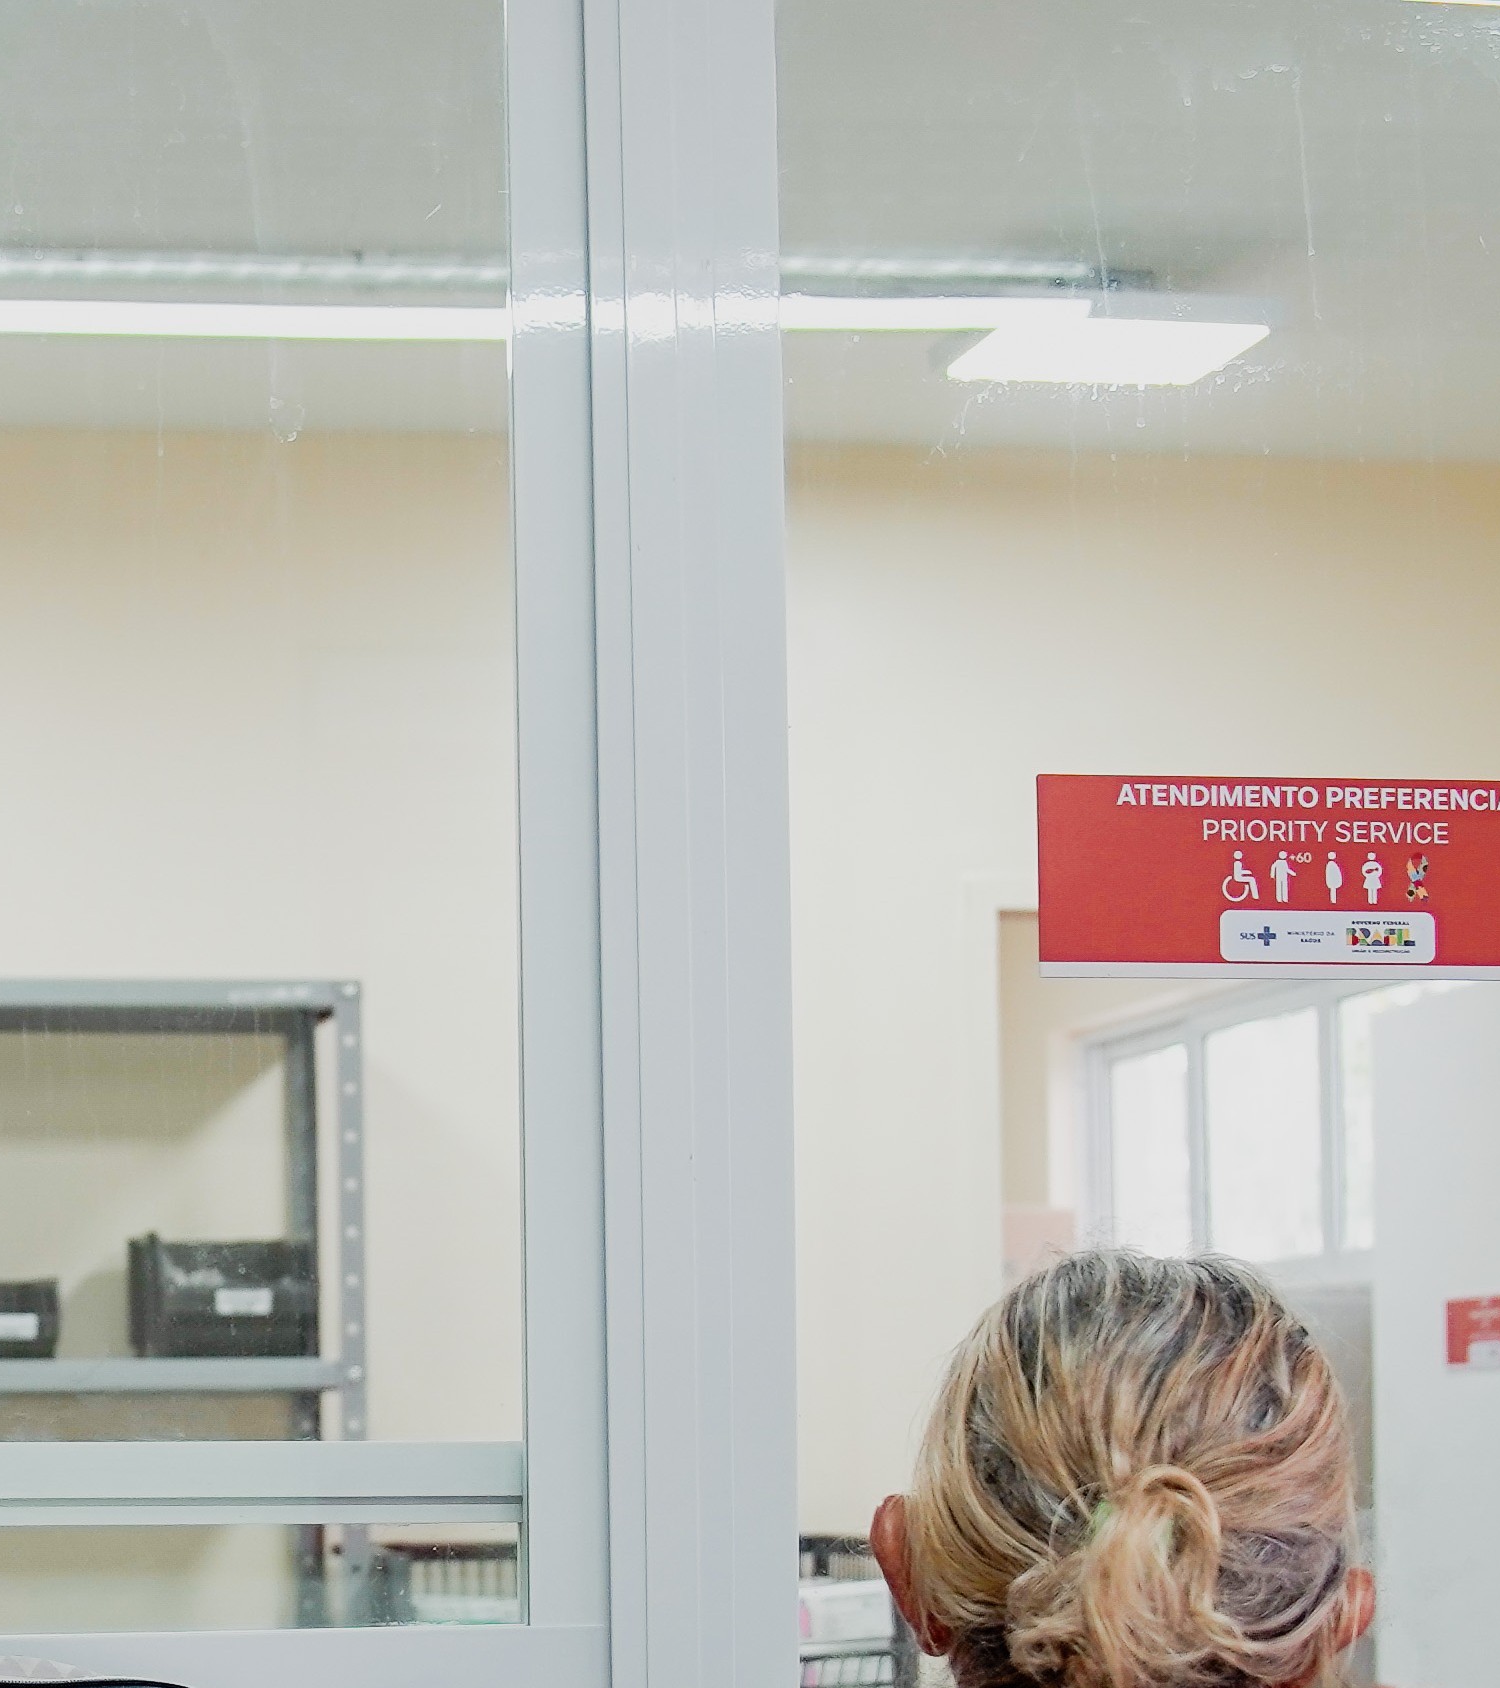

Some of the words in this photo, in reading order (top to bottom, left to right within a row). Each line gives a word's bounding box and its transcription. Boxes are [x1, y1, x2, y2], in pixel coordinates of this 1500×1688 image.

[1116, 783, 1319, 808] ATENDIMENTO
[1202, 819, 1328, 842] PRIORITY
[1335, 821, 1449, 844] SERVICE
[1289, 852, 1312, 864] +60
[1240, 932, 1256, 940] SUS
[1346, 927, 1416, 947] BRASIL
